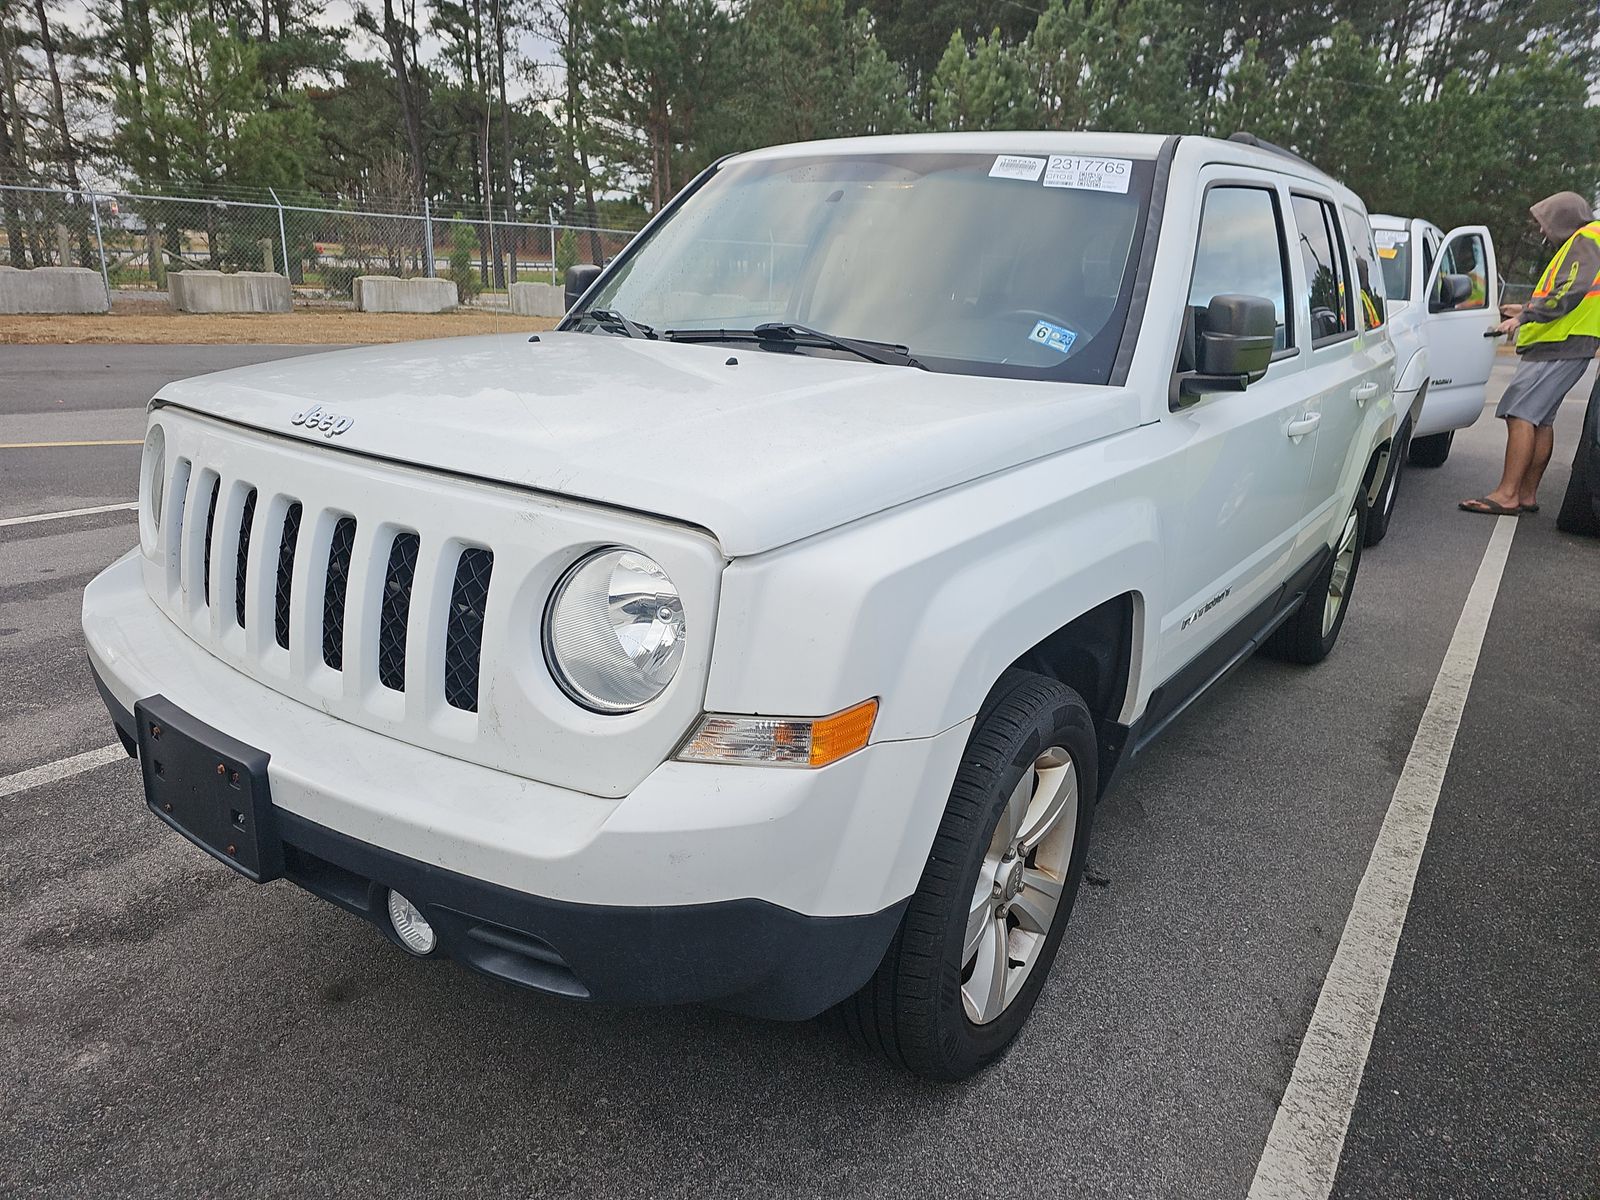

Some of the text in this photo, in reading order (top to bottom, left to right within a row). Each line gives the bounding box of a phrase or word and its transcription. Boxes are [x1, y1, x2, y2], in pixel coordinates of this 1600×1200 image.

[1051, 158, 1126, 175] 2317765
[1037, 327, 1048, 338] 6
[1060, 334, 1073, 346] 23
[291, 404, 354, 438] Jeep
